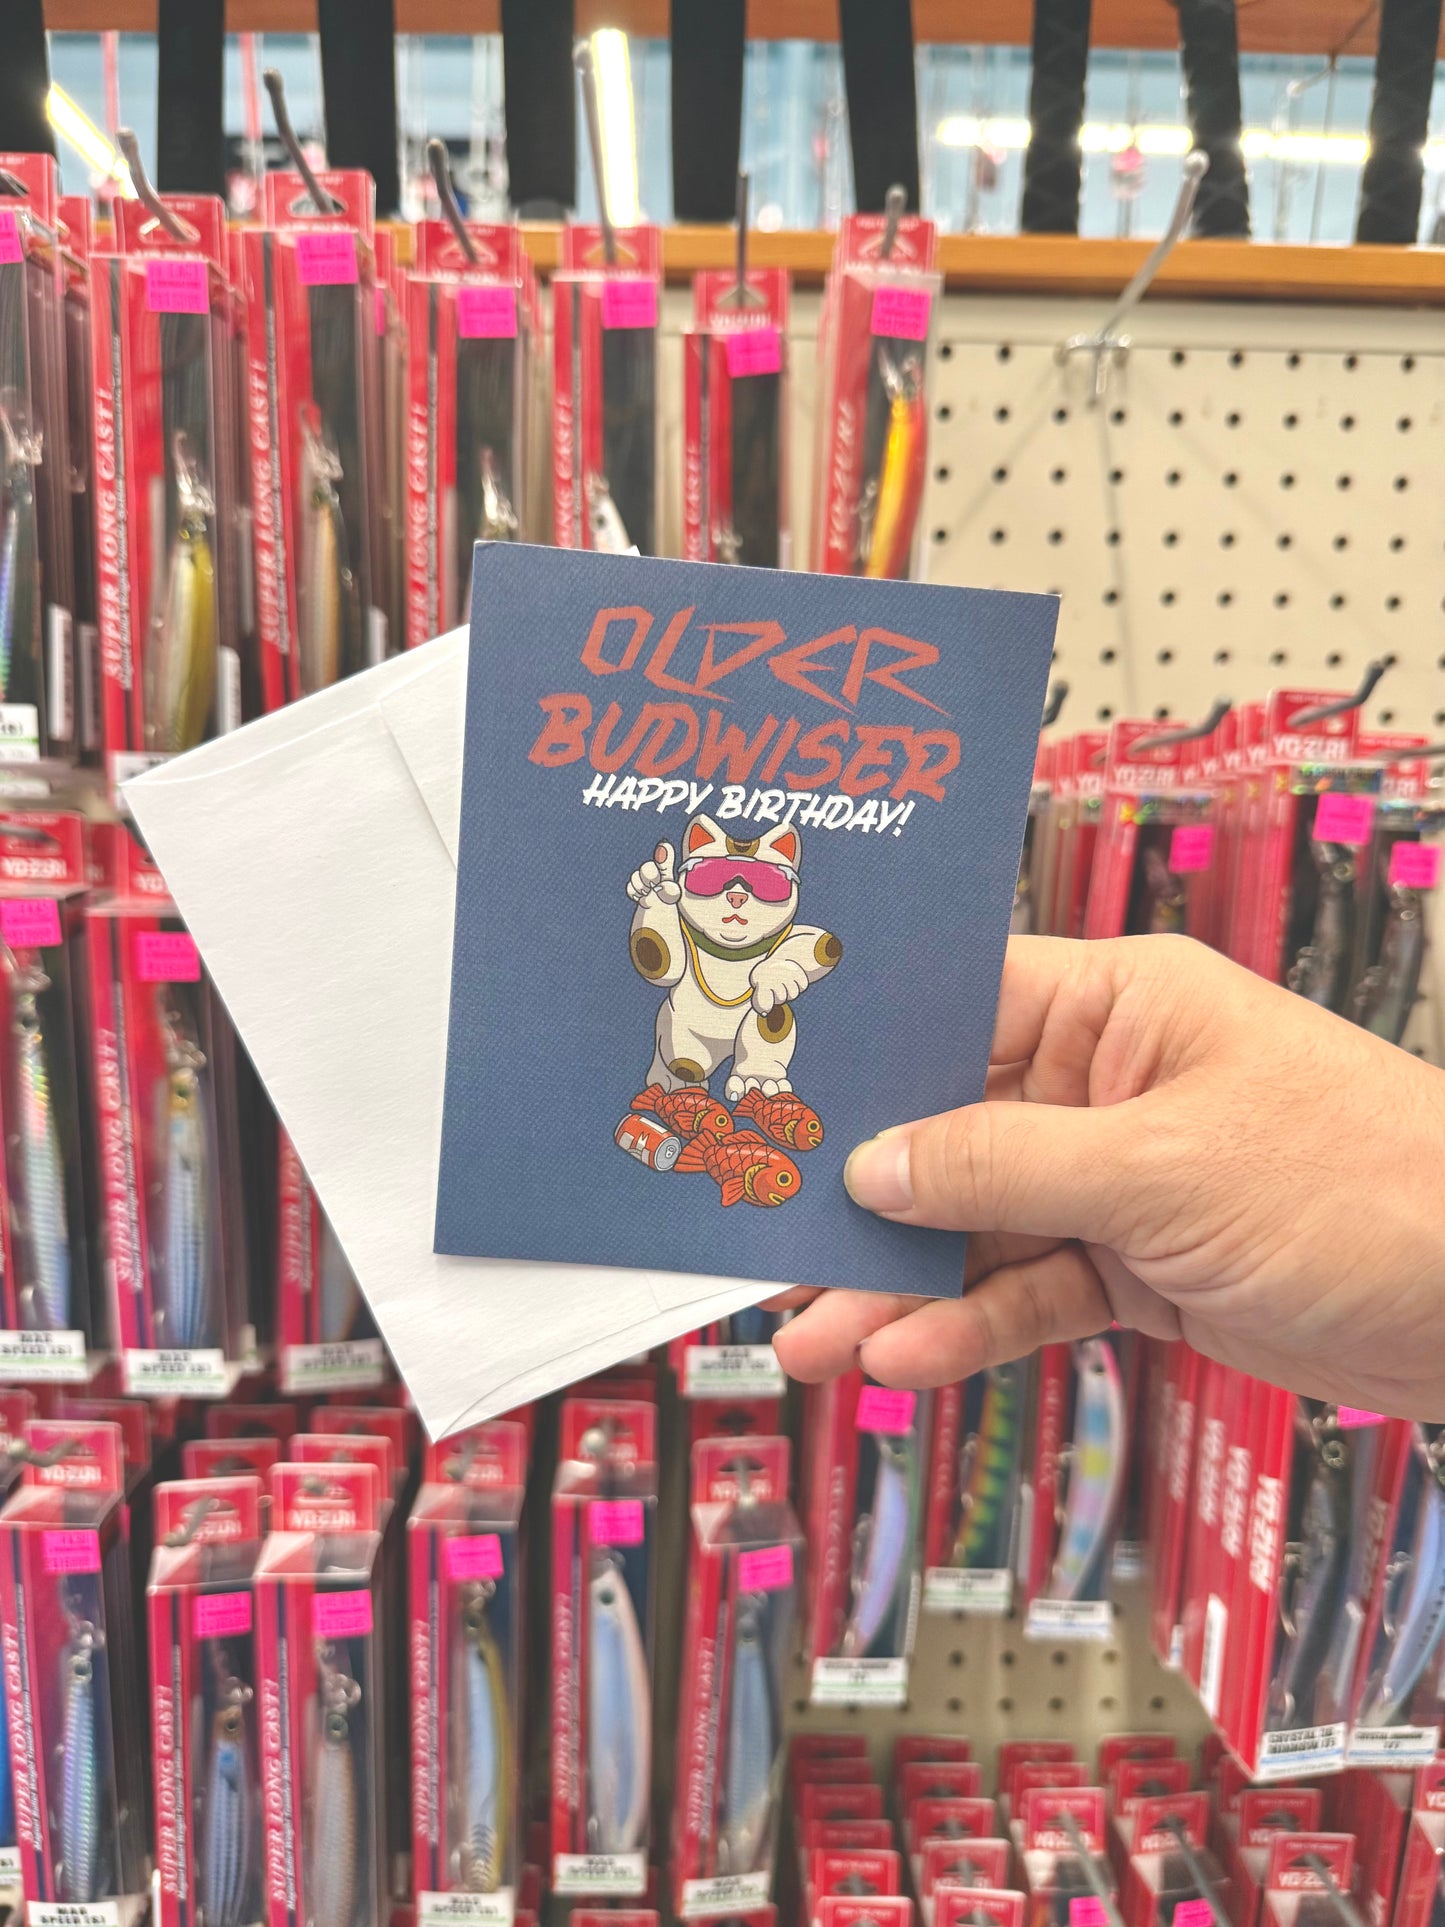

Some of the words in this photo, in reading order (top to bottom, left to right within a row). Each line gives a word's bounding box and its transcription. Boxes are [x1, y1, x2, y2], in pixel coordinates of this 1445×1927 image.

[96, 386, 115, 481] CAST!
[98, 489, 118, 577] LONG
[251, 457, 275, 544] LONG
[408, 500, 428, 587] LONG
[100, 580, 122, 679] SUPER
[580, 605, 953, 718] OLDER
[528, 692, 962, 802] BUDWISER
[582, 773, 714, 815] HAPPY
[715, 785, 916, 837] BIRTHDAY!
[107, 1200, 134, 1281] SUPER
[2, 1622, 22, 1696] CAST!
[9, 1699, 27, 1764] LONG
[155, 1685, 174, 1754] CAST!
[262, 1679, 281, 1752] CAST!
[13, 1769, 33, 1841] SUPER
[158, 1759, 176, 1820] LONG
[263, 1757, 284, 1823] LONG
[160, 1825, 178, 1892] SUPER
[267, 1828, 287, 1901] SUPER
